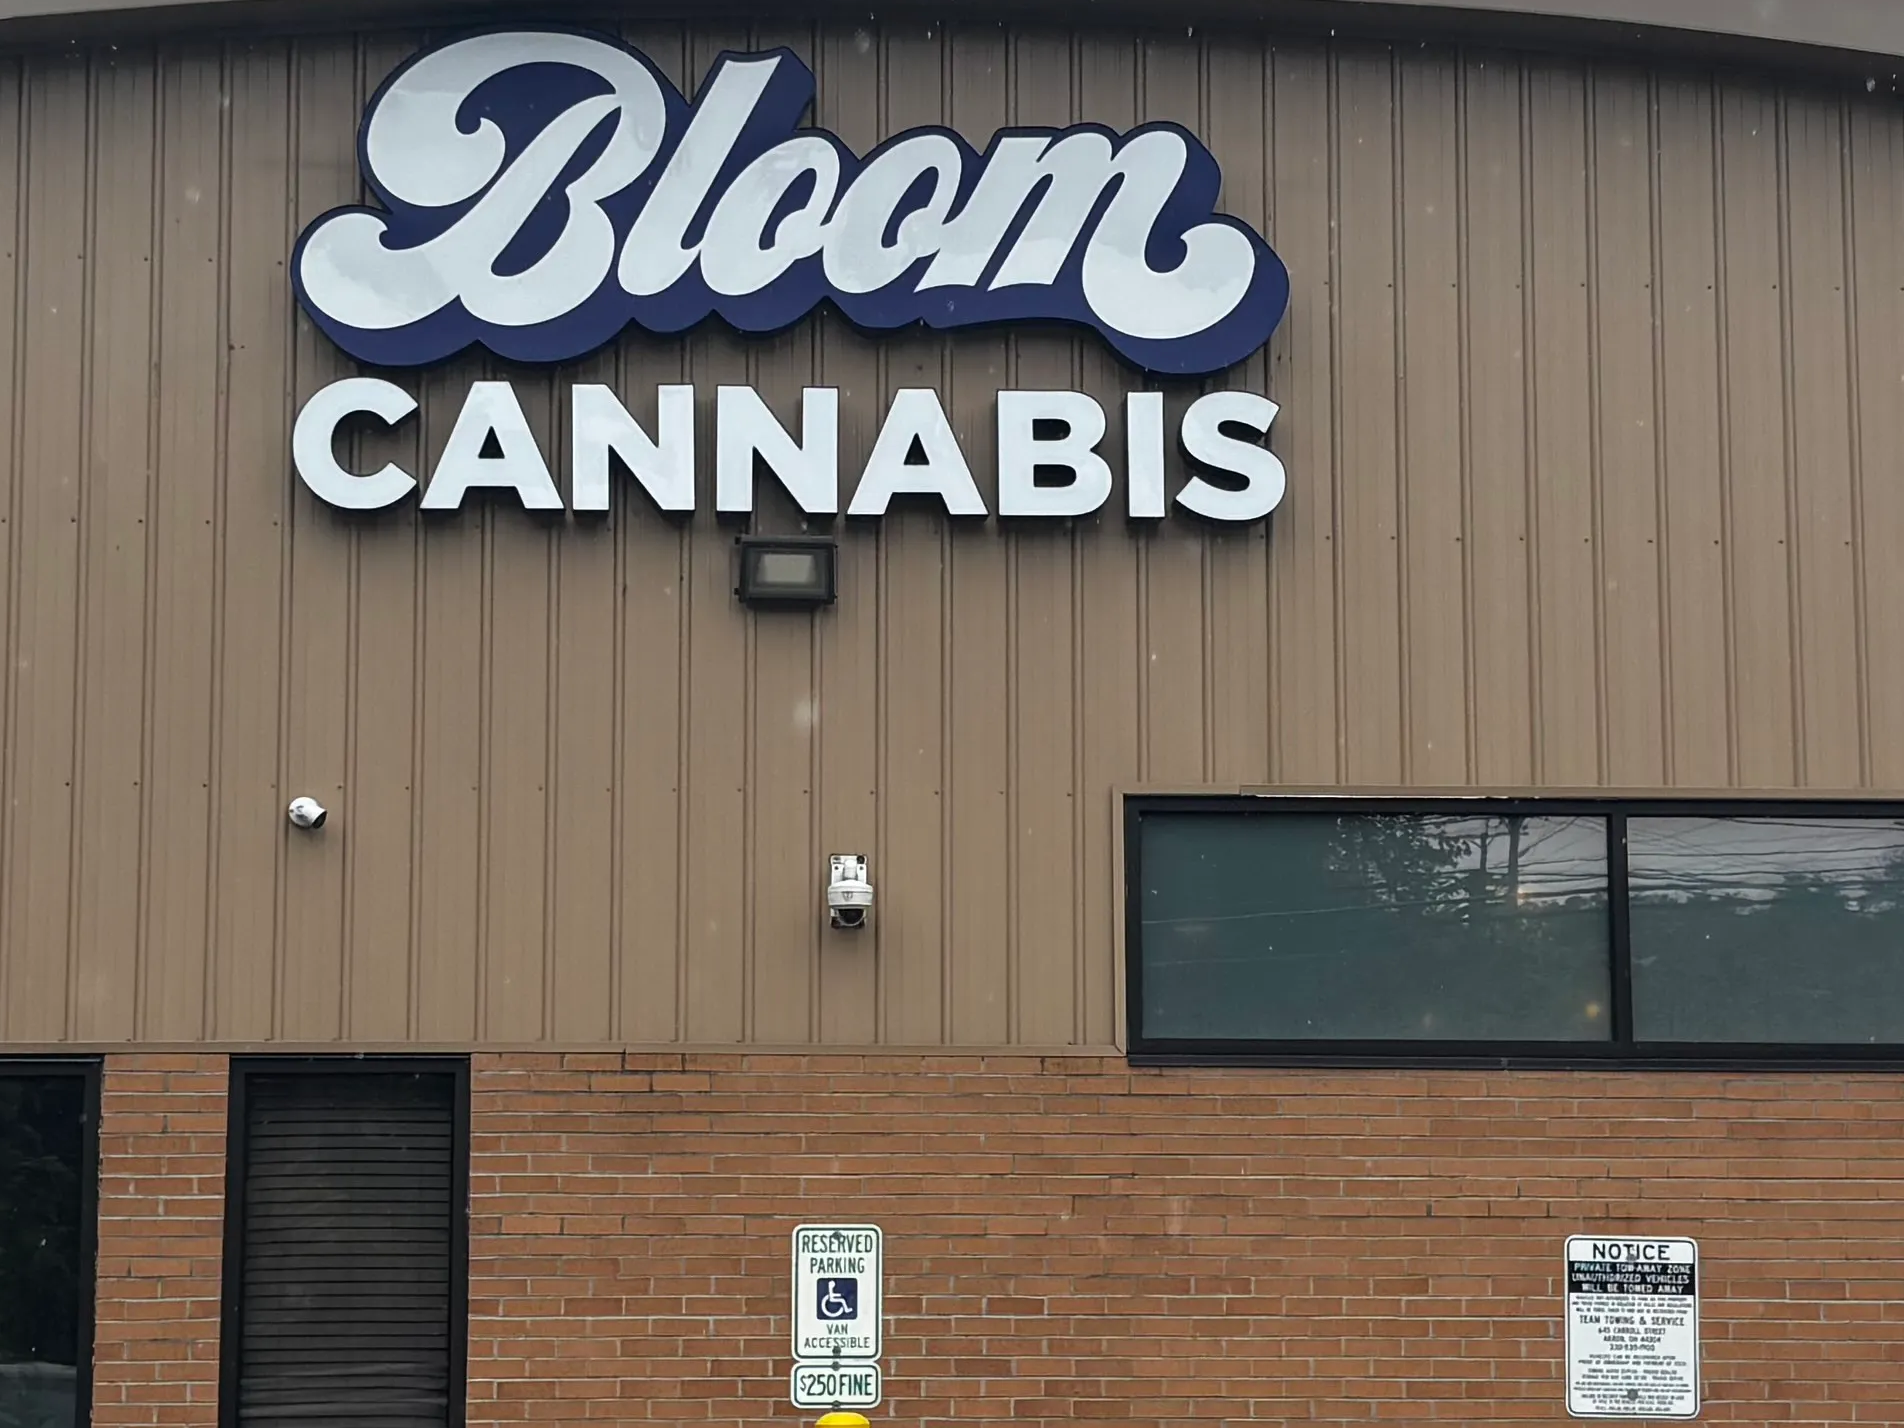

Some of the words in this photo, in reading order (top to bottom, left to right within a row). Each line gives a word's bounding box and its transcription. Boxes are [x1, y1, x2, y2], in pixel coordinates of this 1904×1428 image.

[295, 27, 1266, 344] Bloom
[292, 376, 1288, 522] CANNABIS
[802, 1234, 873, 1254] RESERVED
[1592, 1243, 1671, 1261] NOTICE
[810, 1257, 865, 1274] PARKING
[1574, 1263, 1613, 1273] PRIVATE
[1667, 1265, 1692, 1274] ZONE
[1571, 1273, 1642, 1283] UNAUTHORIZED
[1645, 1274, 1690, 1284] VEHICLES
[1581, 1283, 1604, 1292] WILL
[1607, 1283, 1619, 1292] BE
[1623, 1284, 1654, 1293] TOWED
[1657, 1285, 1684, 1294] AWAY
[1651, 1316, 1685, 1326] SERVICE
[826, 1323, 849, 1336] VAN
[804, 1337, 870, 1349] ACCESSIBLE
[800, 1374, 837, 1396] $250
[839, 1374, 873, 1396] FINE
